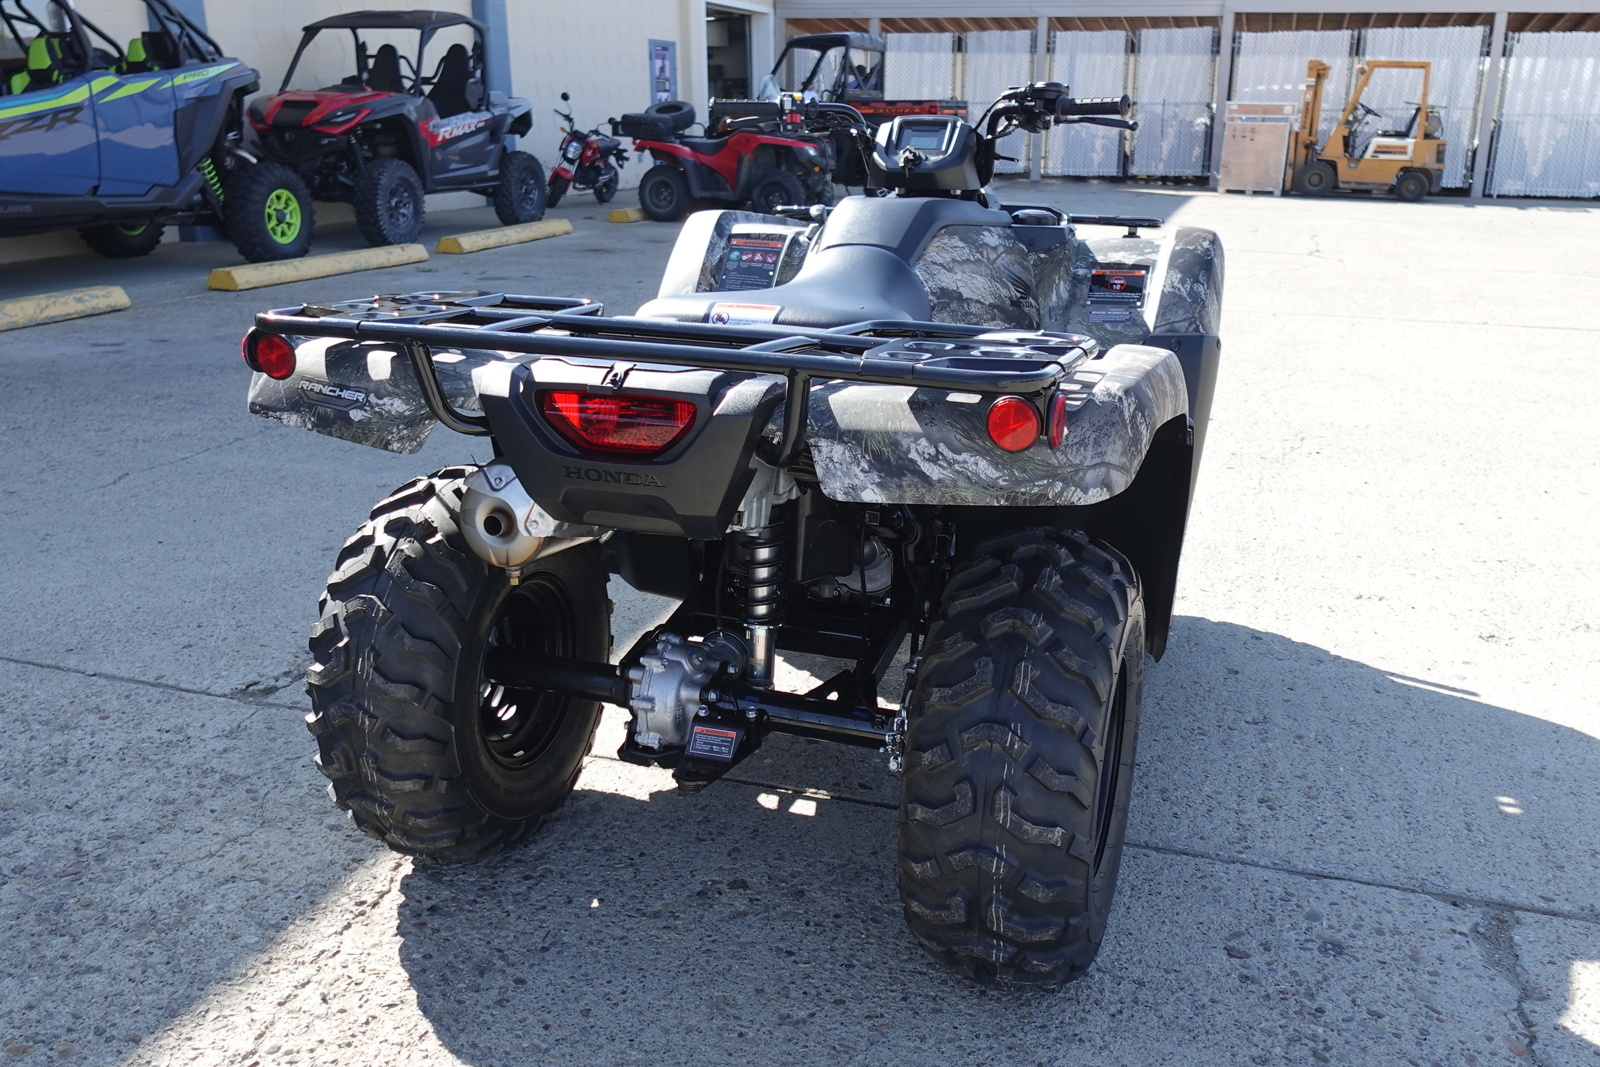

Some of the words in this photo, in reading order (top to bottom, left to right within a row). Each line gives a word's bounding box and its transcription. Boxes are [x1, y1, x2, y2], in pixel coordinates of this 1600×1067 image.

[183, 70, 209, 80] PRO
[298, 380, 366, 402] RANCHER
[562, 465, 666, 488] HONDA
